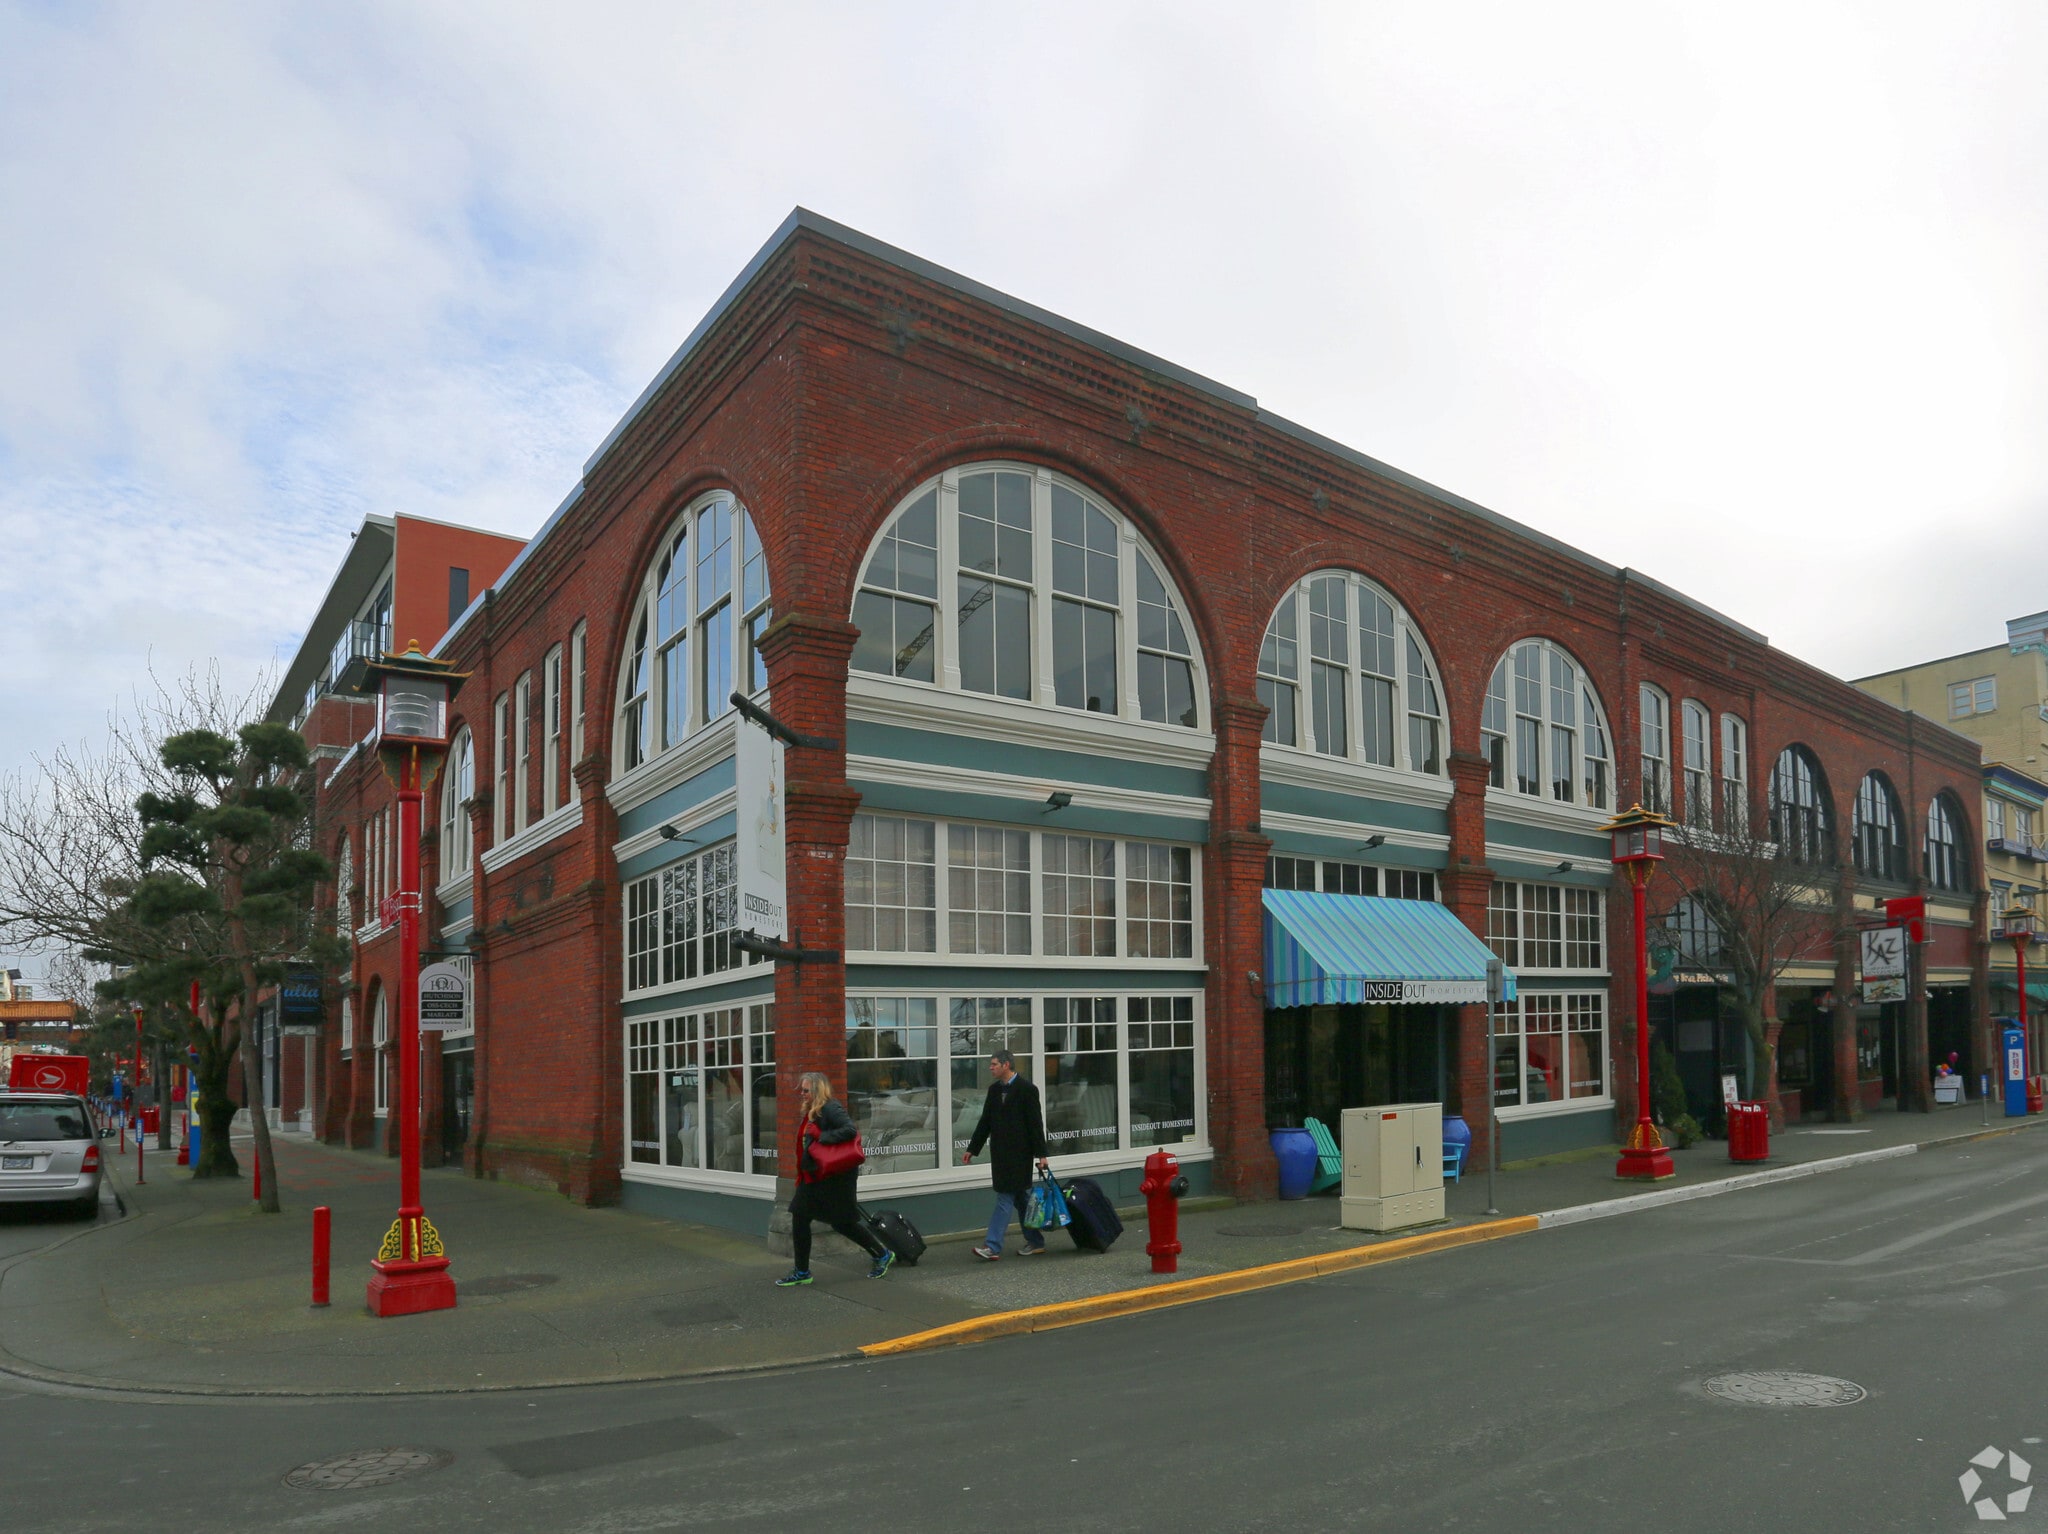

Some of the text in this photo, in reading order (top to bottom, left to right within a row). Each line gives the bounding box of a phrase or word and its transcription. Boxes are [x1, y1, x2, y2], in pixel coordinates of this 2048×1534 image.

[745, 895, 782, 917] INSIDE OUT
[1866, 932, 1903, 966] KAZ
[1366, 984, 1401, 998] INSIDE
[1403, 983, 1427, 998] OUT
[2010, 1036, 2018, 1045] P
[1132, 1118, 1194, 1131] INSIDEOUT HOMESTORE
[1048, 1125, 1117, 1141] INSIDEOUT HOMESTORE
[862, 1142, 937, 1156] IDEOUT HOMESTORE
